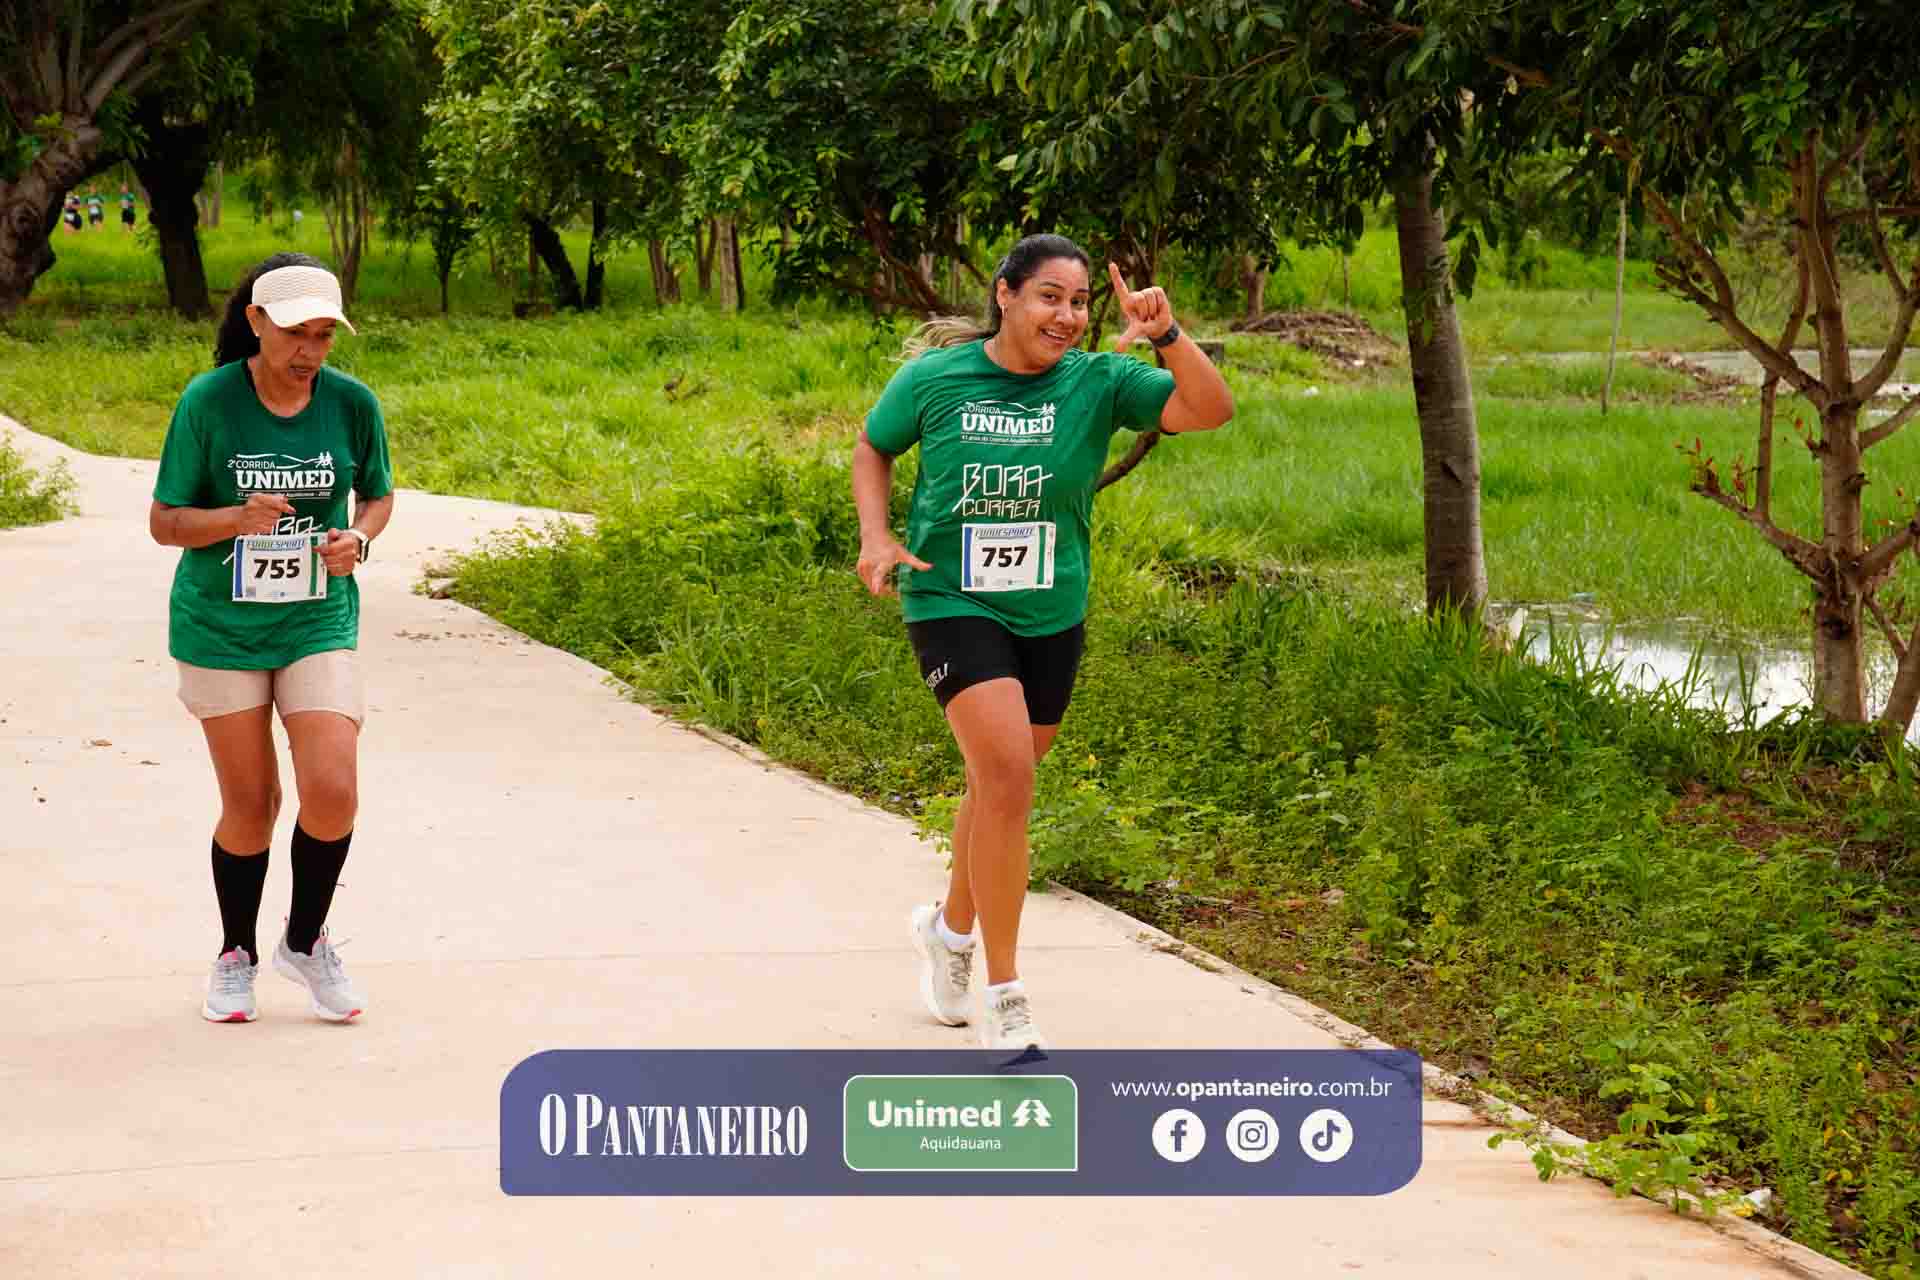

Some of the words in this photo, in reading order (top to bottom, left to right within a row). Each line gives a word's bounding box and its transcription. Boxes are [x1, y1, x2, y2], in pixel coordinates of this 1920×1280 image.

[962, 413, 1055, 435] UNIMED
[235, 460, 276, 470] CORRIDA
[235, 469, 336, 489] UNIMED
[952, 463, 1053, 513] BORA
[962, 499, 1041, 519] CORRER
[981, 546, 1029, 568] 757
[253, 558, 300, 579] 755
